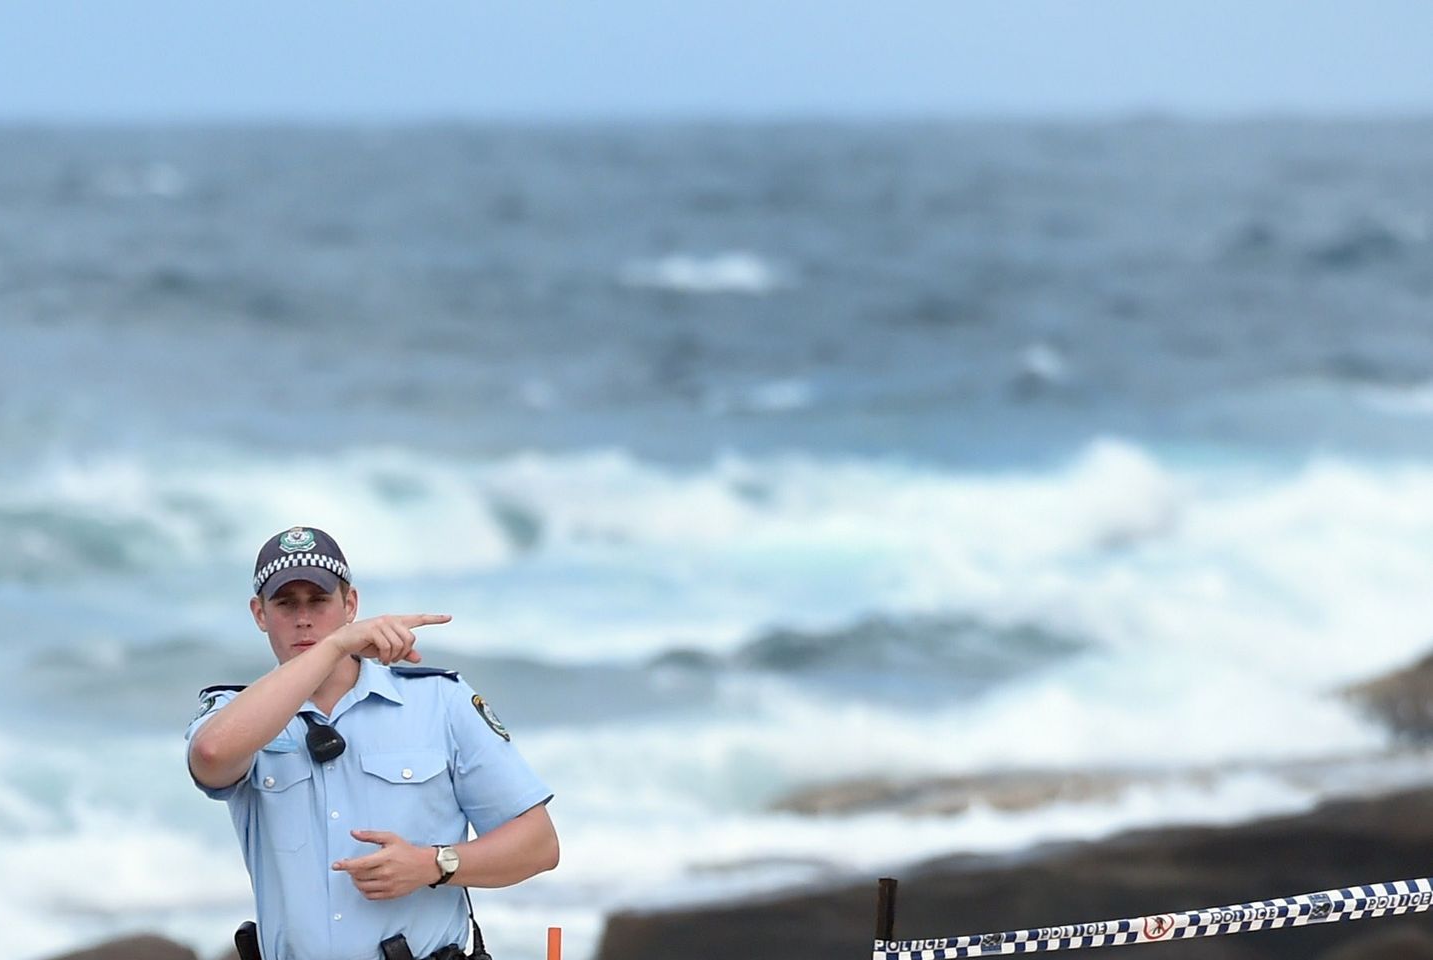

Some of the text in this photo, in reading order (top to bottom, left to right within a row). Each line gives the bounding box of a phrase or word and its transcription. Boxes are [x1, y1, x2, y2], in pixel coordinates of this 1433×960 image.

[1368, 892, 1431, 908] POLICE
[1212, 907, 1276, 924] POLICE
[1041, 923, 1107, 939] POLICE
[874, 939, 947, 951] POLICE
